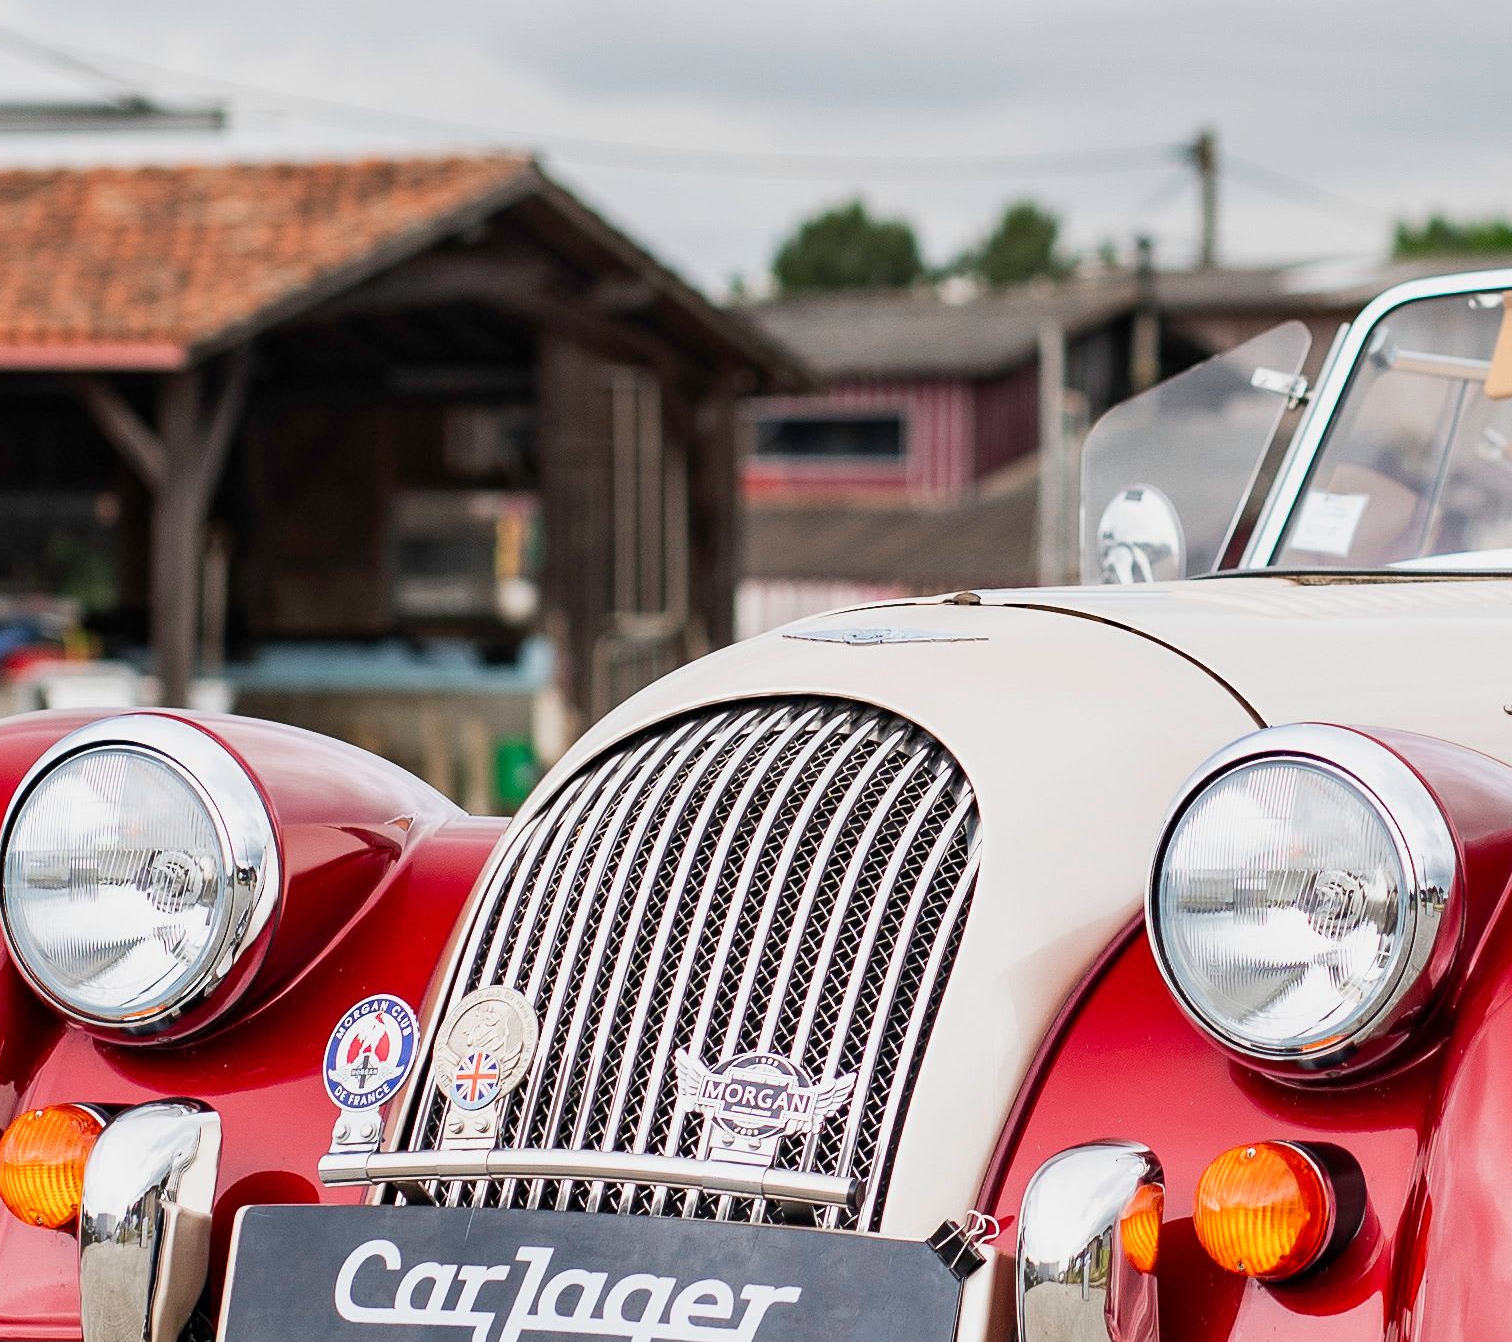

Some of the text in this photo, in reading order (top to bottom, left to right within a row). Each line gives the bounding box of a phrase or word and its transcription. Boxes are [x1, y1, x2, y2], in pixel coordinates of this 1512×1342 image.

[336, 1001, 389, 1040] MORGAN
[391, 1005, 412, 1037] CLUB
[334, 1083, 391, 1106] DE FRANCE
[704, 1079, 810, 1113] MORGAN
